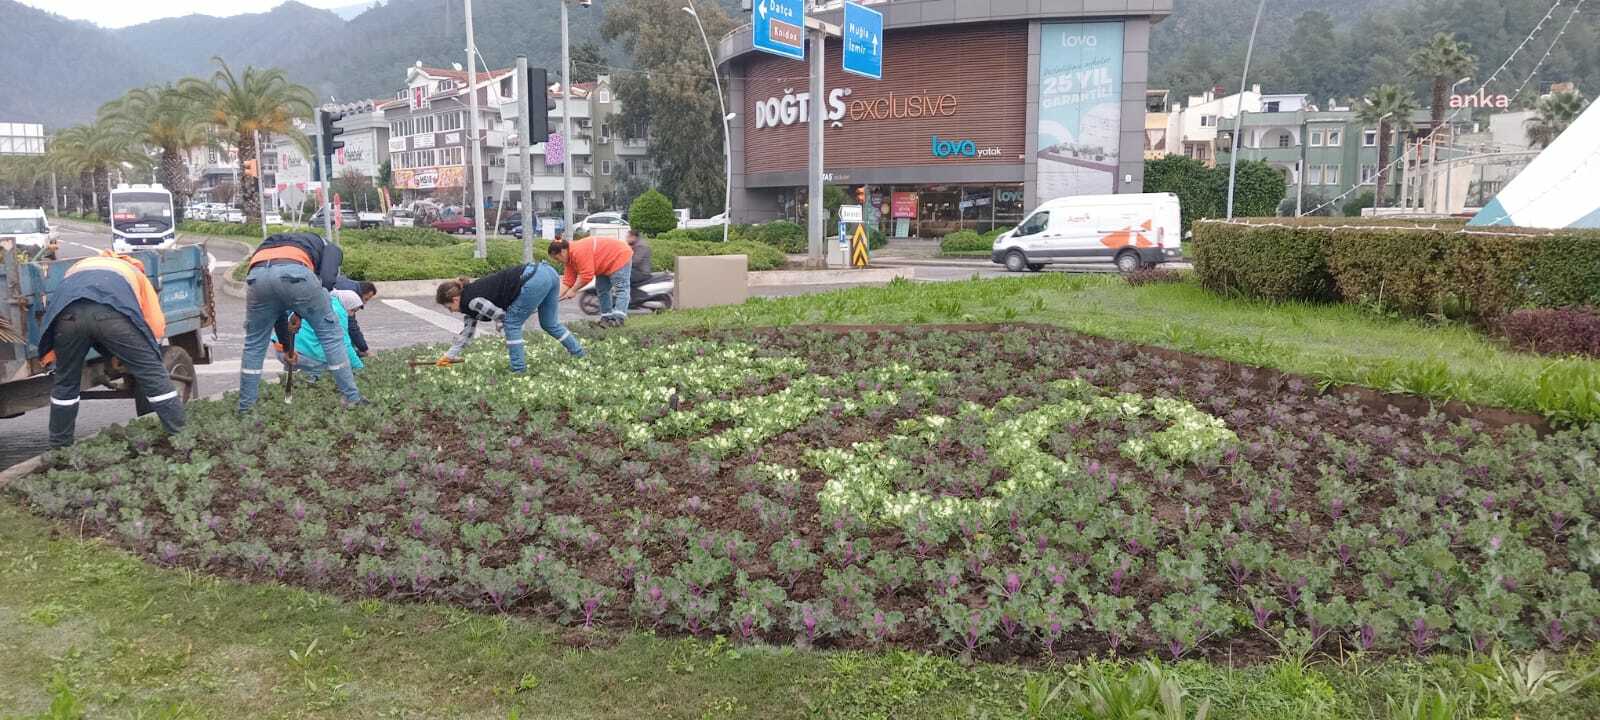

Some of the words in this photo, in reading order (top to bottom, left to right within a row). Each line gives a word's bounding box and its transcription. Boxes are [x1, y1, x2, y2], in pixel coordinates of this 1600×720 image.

[769, 0, 793, 17] Datça
[774, 26, 798, 41] Knidos
[849, 23, 869, 39] Muğla
[849, 39, 867, 55] İzmir
[1062, 32, 1097, 48] lova
[1043, 73, 1073, 95] 25
[1076, 67, 1113, 90] YIL
[850, 89, 957, 121] exclusive
[930, 134, 977, 158] lova
[977, 147, 1002, 157] yatak
